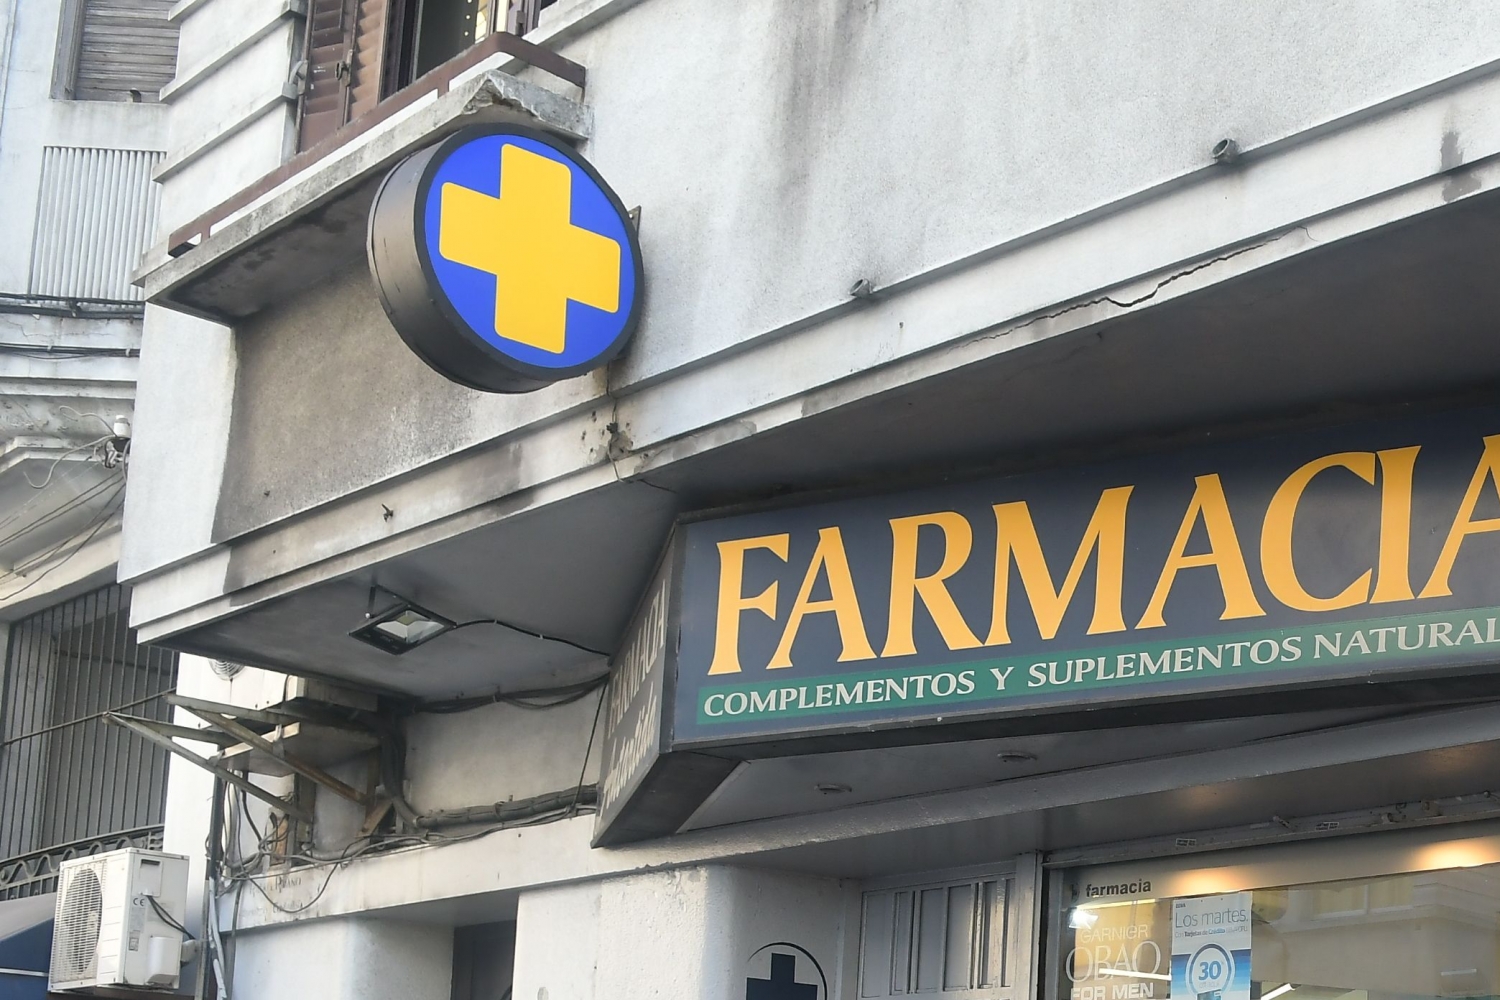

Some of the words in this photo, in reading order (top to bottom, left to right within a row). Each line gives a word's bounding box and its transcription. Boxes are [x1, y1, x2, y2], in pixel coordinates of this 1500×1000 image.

[703, 669, 976, 718] COMPLEMENTOS
[989, 666, 1015, 691] Y
[1027, 635, 1303, 688] SUPLEMENTOS
[1086, 878, 1152, 898] farmacia
[1175, 912, 1199, 929] Los
[1201, 908, 1249, 926] martes.
[1199, 960, 1222, 981] 30
[1112, 982, 1154, 1000] MEN
